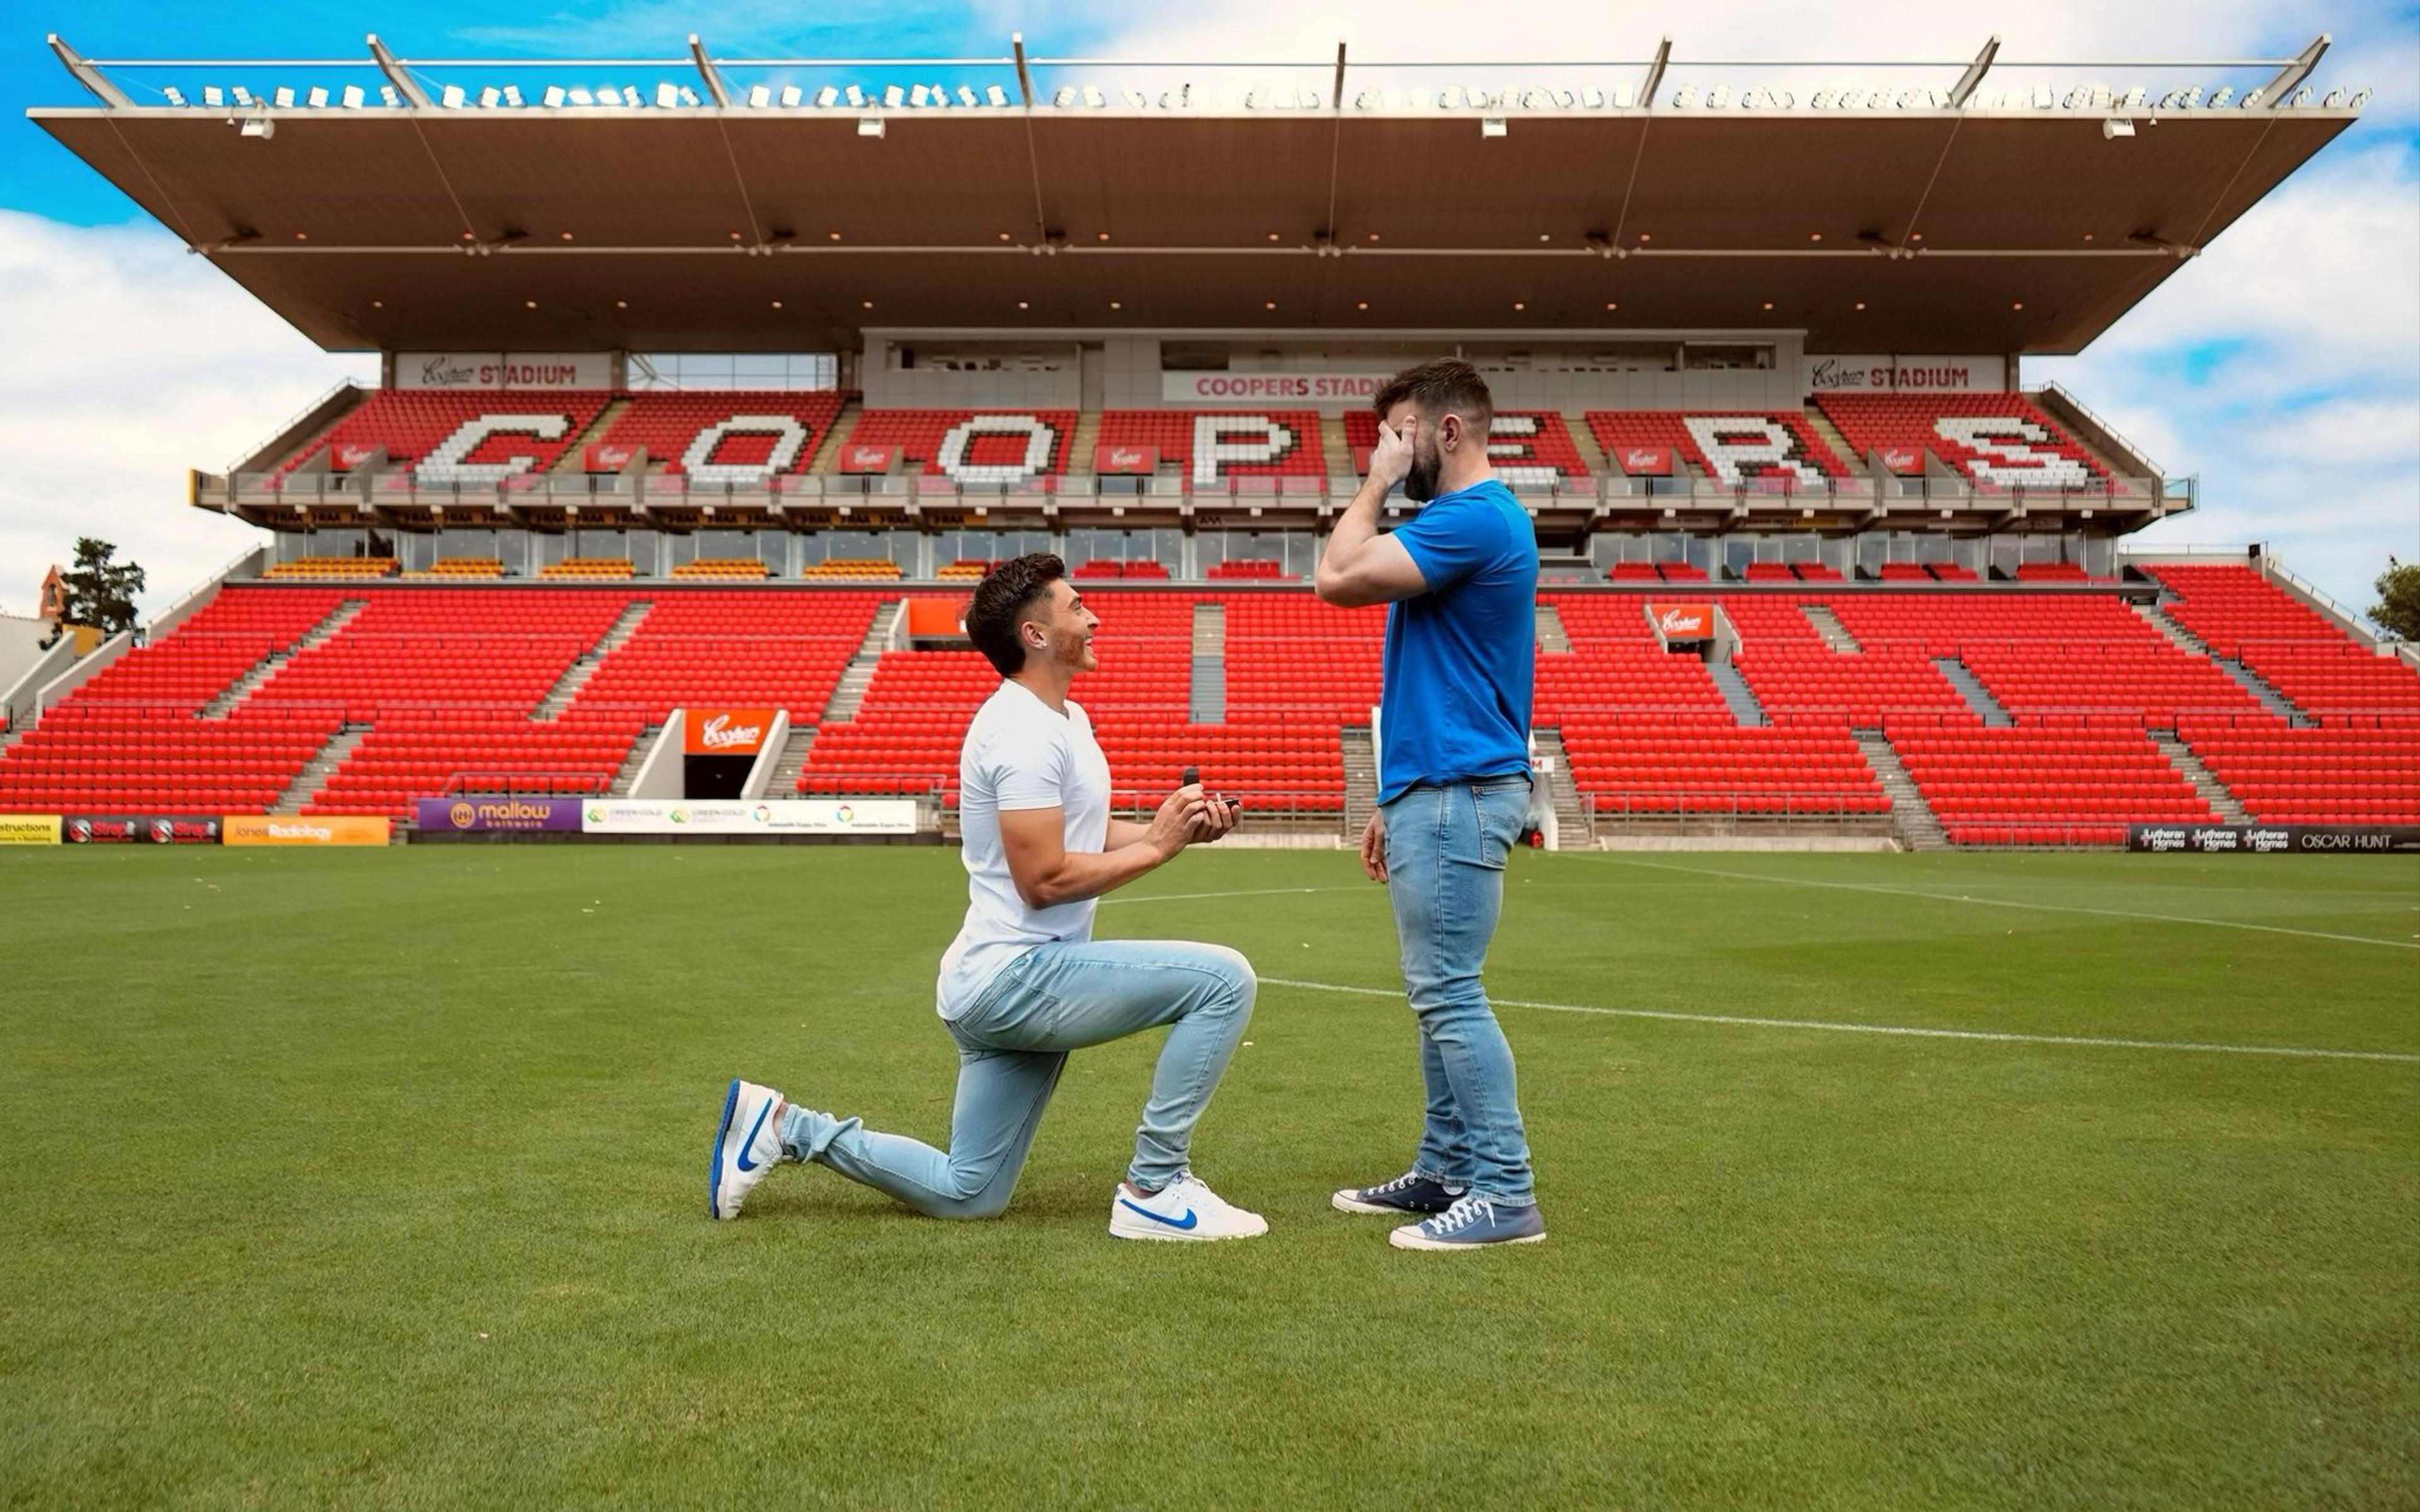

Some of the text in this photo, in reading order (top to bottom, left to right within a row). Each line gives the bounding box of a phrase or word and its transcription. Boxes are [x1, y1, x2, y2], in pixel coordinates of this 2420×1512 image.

[480, 365, 576, 384] STADIUM
[1870, 367, 1969, 387] STADIUM
[1196, 377, 1386, 396] COOPERS STAD
[478, 801, 551, 819] mallow
[2143, 828, 2186, 839] Lutheran
[2194, 828, 2237, 839] Lutheran
[2246, 828, 2288, 839] Lutheran
[2153, 839, 2186, 848] Homes
[2204, 839, 2237, 848] Homes
[2256, 839, 2288, 848] Homes
[2302, 833, 2351, 849] OSCAR
[2355, 834, 2392, 849] HUNT
